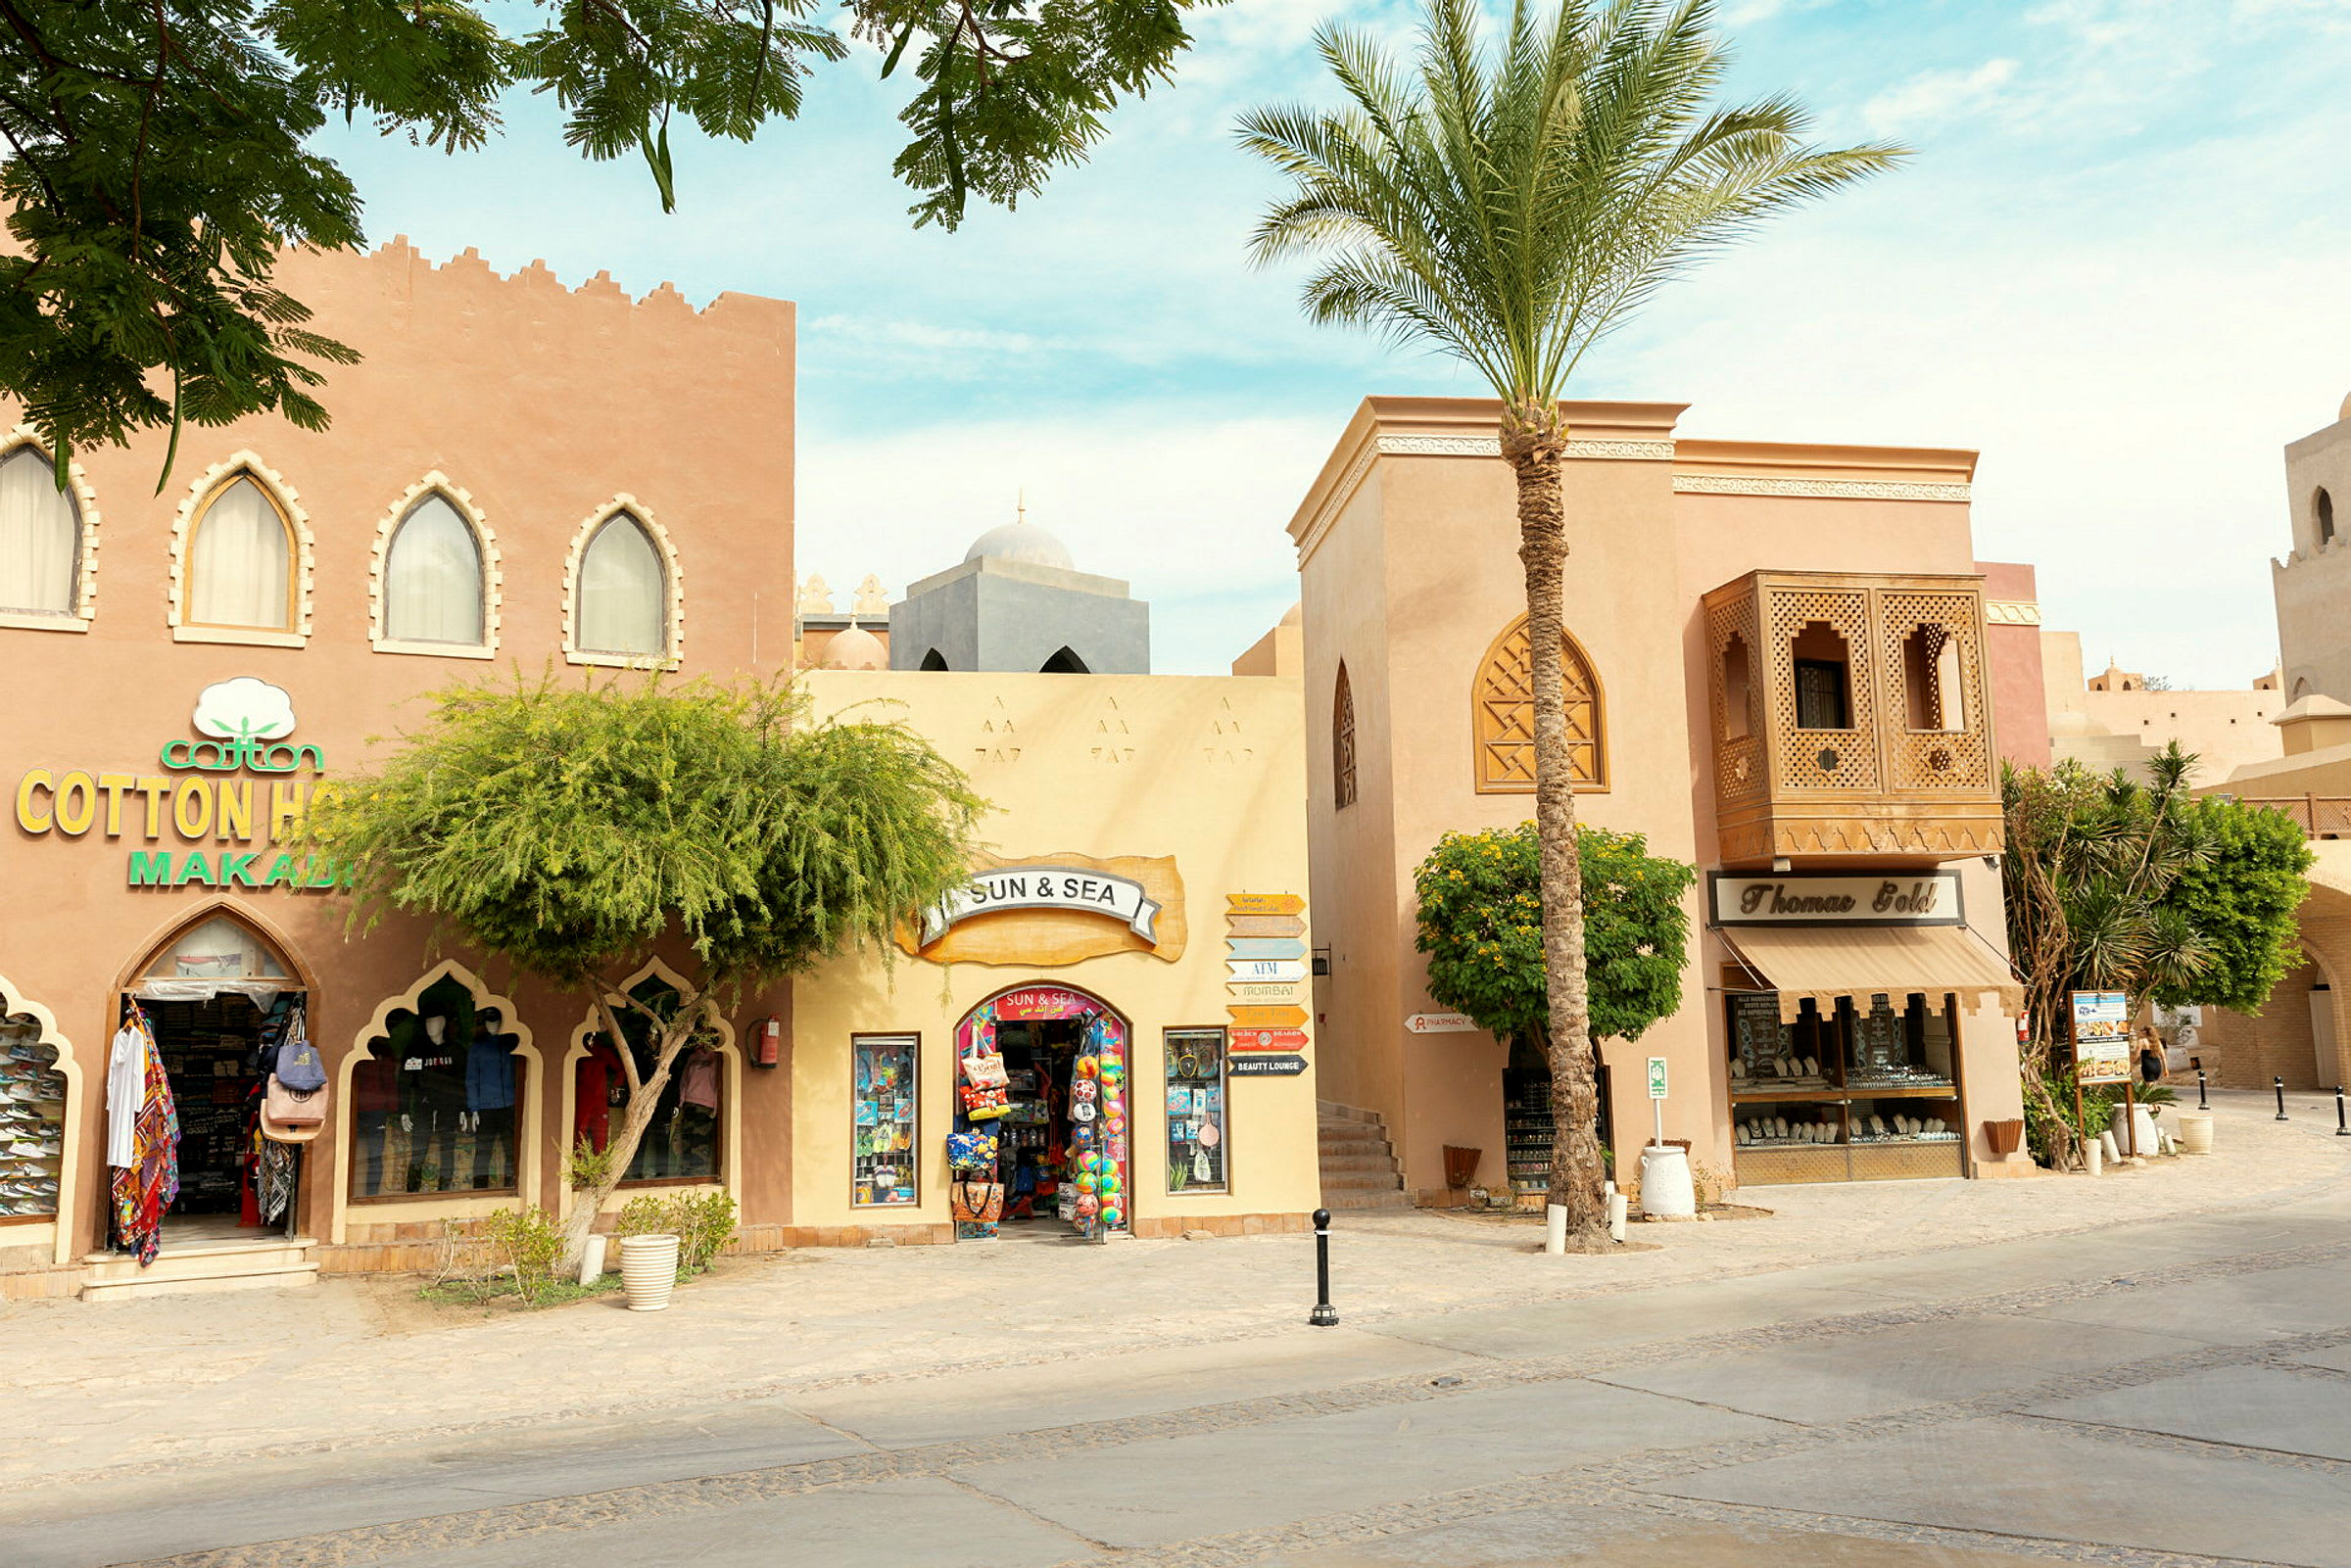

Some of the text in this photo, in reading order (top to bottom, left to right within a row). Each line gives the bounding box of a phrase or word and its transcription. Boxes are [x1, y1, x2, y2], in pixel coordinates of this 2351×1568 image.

[161, 738, 325, 775] cotton
[16, 768, 254, 841] COTTON
[970, 877, 1116, 907] SUN & SEA
[1740, 879, 1939, 915] Thomas Gold
[1252, 962, 1277, 974] ATM
[1243, 985, 1293, 996] MUMBAI
[1006, 992, 1077, 1007] SUN & SEA
[1426, 1018, 1465, 1026] PHARMACY
[1237, 1062, 1300, 1071] BEAUTY LOUNGE
